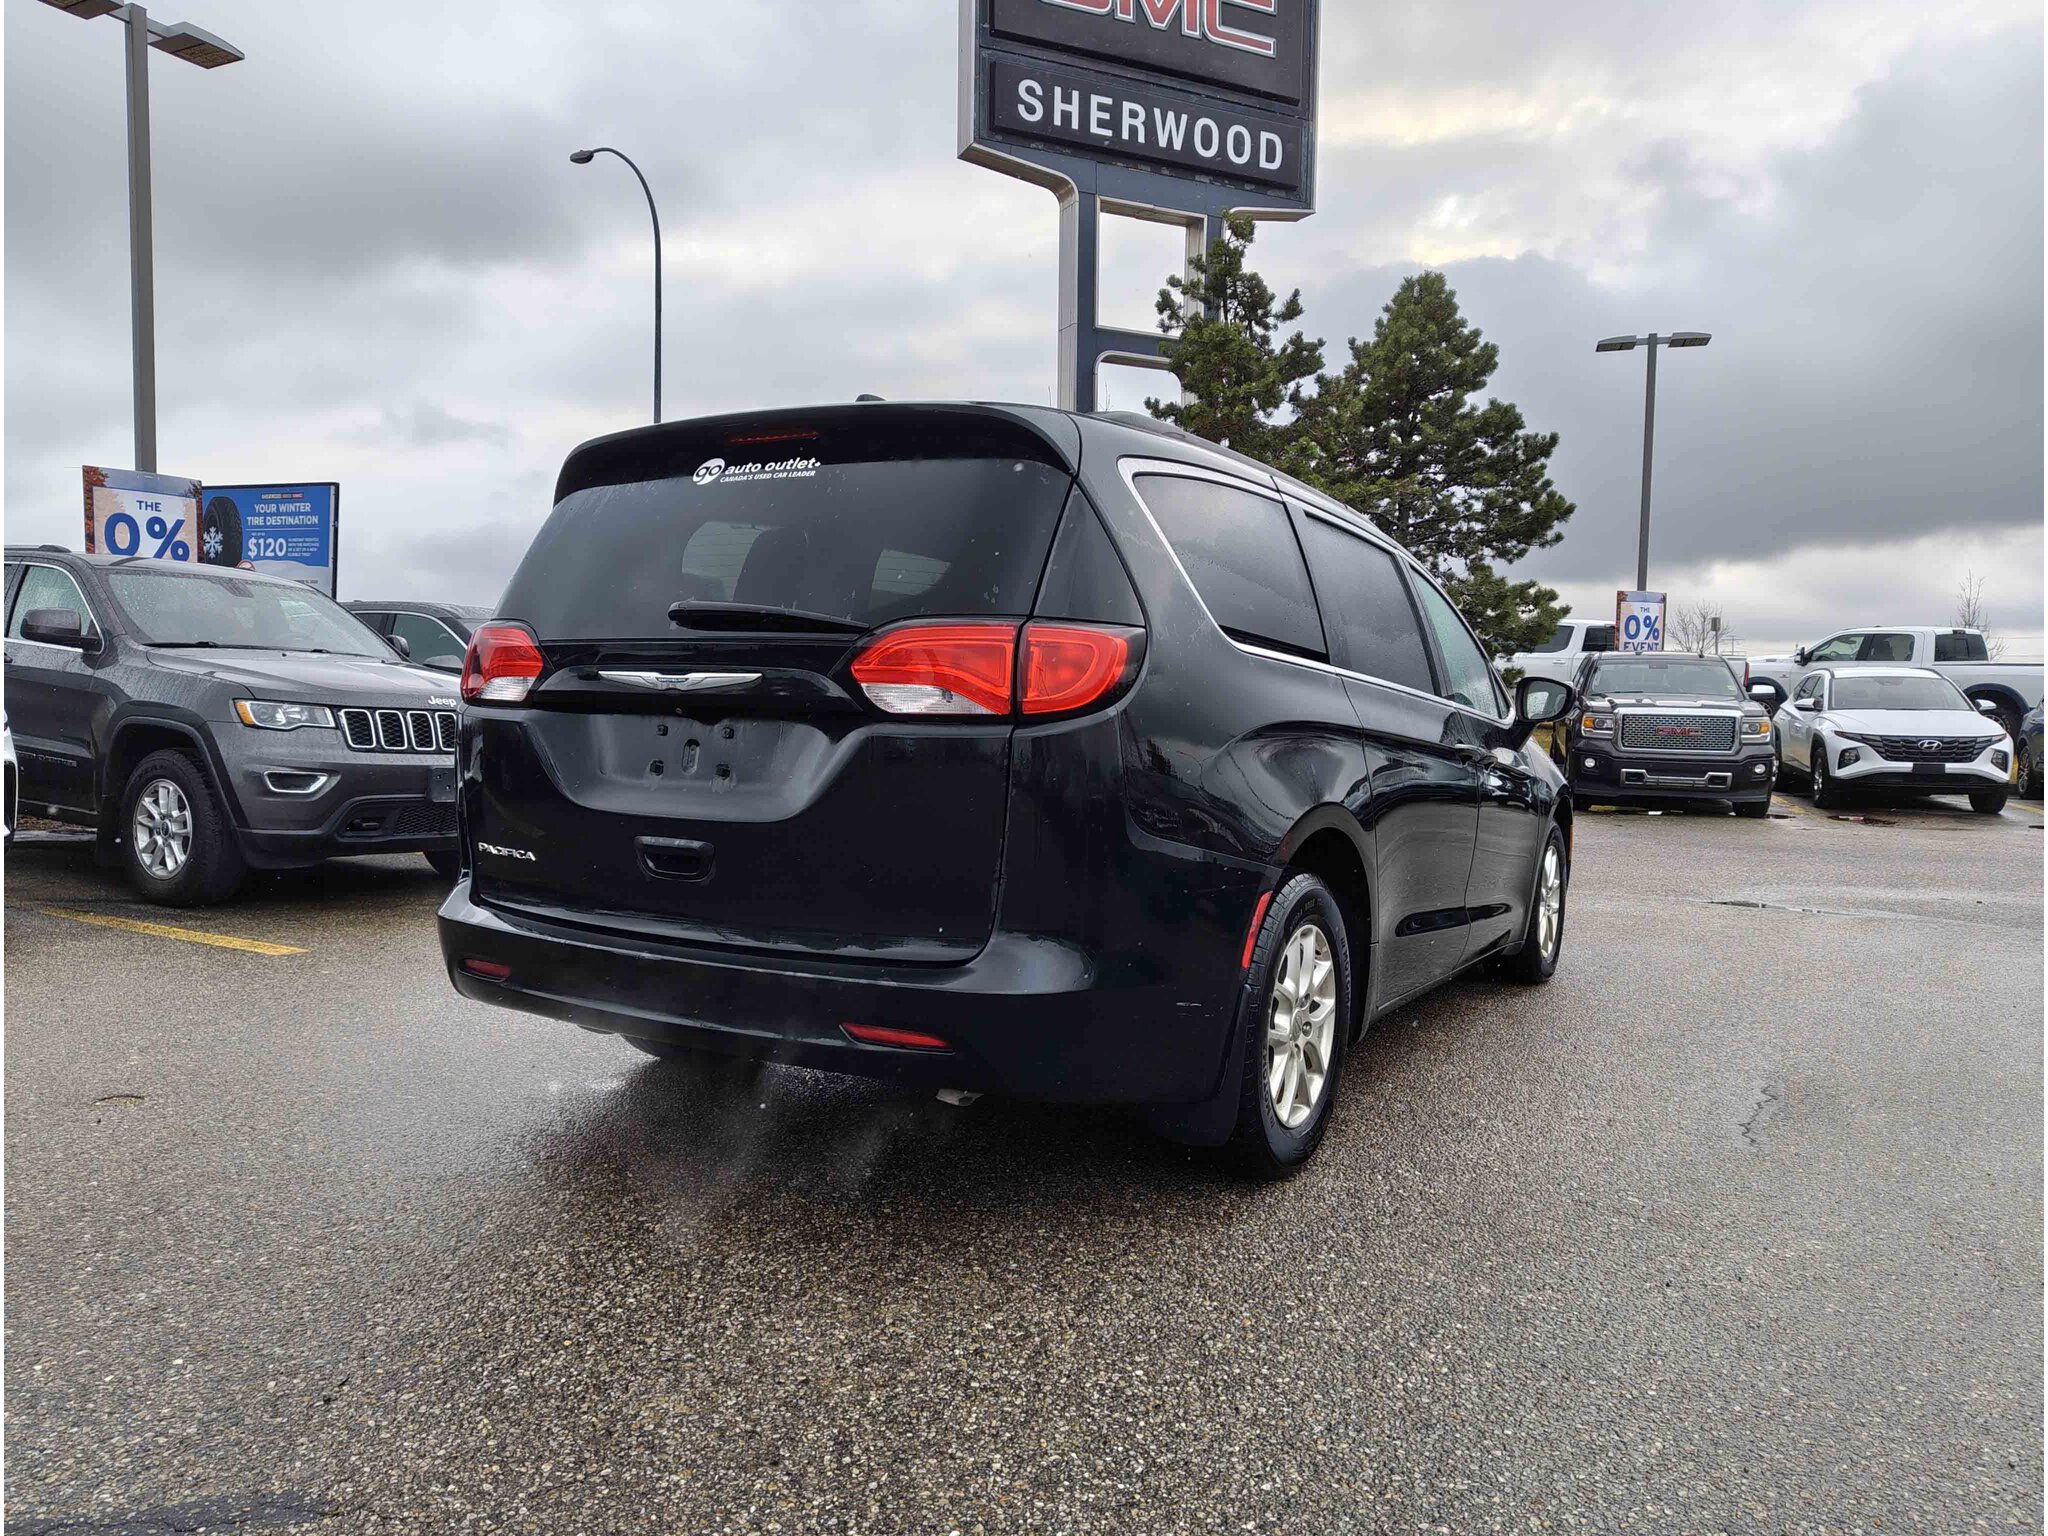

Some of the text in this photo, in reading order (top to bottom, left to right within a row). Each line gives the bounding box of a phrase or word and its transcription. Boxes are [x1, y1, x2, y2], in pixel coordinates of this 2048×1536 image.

[1017, 79, 1284, 170] SHERWOOD
[725, 462, 762, 475] auto
[720, 475, 752, 483] CANADA'S
[788, 470, 815, 478] LEADER
[136, 500, 162, 512] THE
[254, 503, 311, 513] YOUR WINTER
[247, 515, 319, 526] TIRE DESTINATION
[104, 512, 190, 562] 0%
[248, 537, 287, 559] $120
[1624, 615, 1660, 640] 0%
[1624, 642, 1659, 651] EVENT
[428, 695, 457, 707] Jeep
[1655, 726, 1703, 737] GMC
[478, 841, 536, 861] PACIFICA
